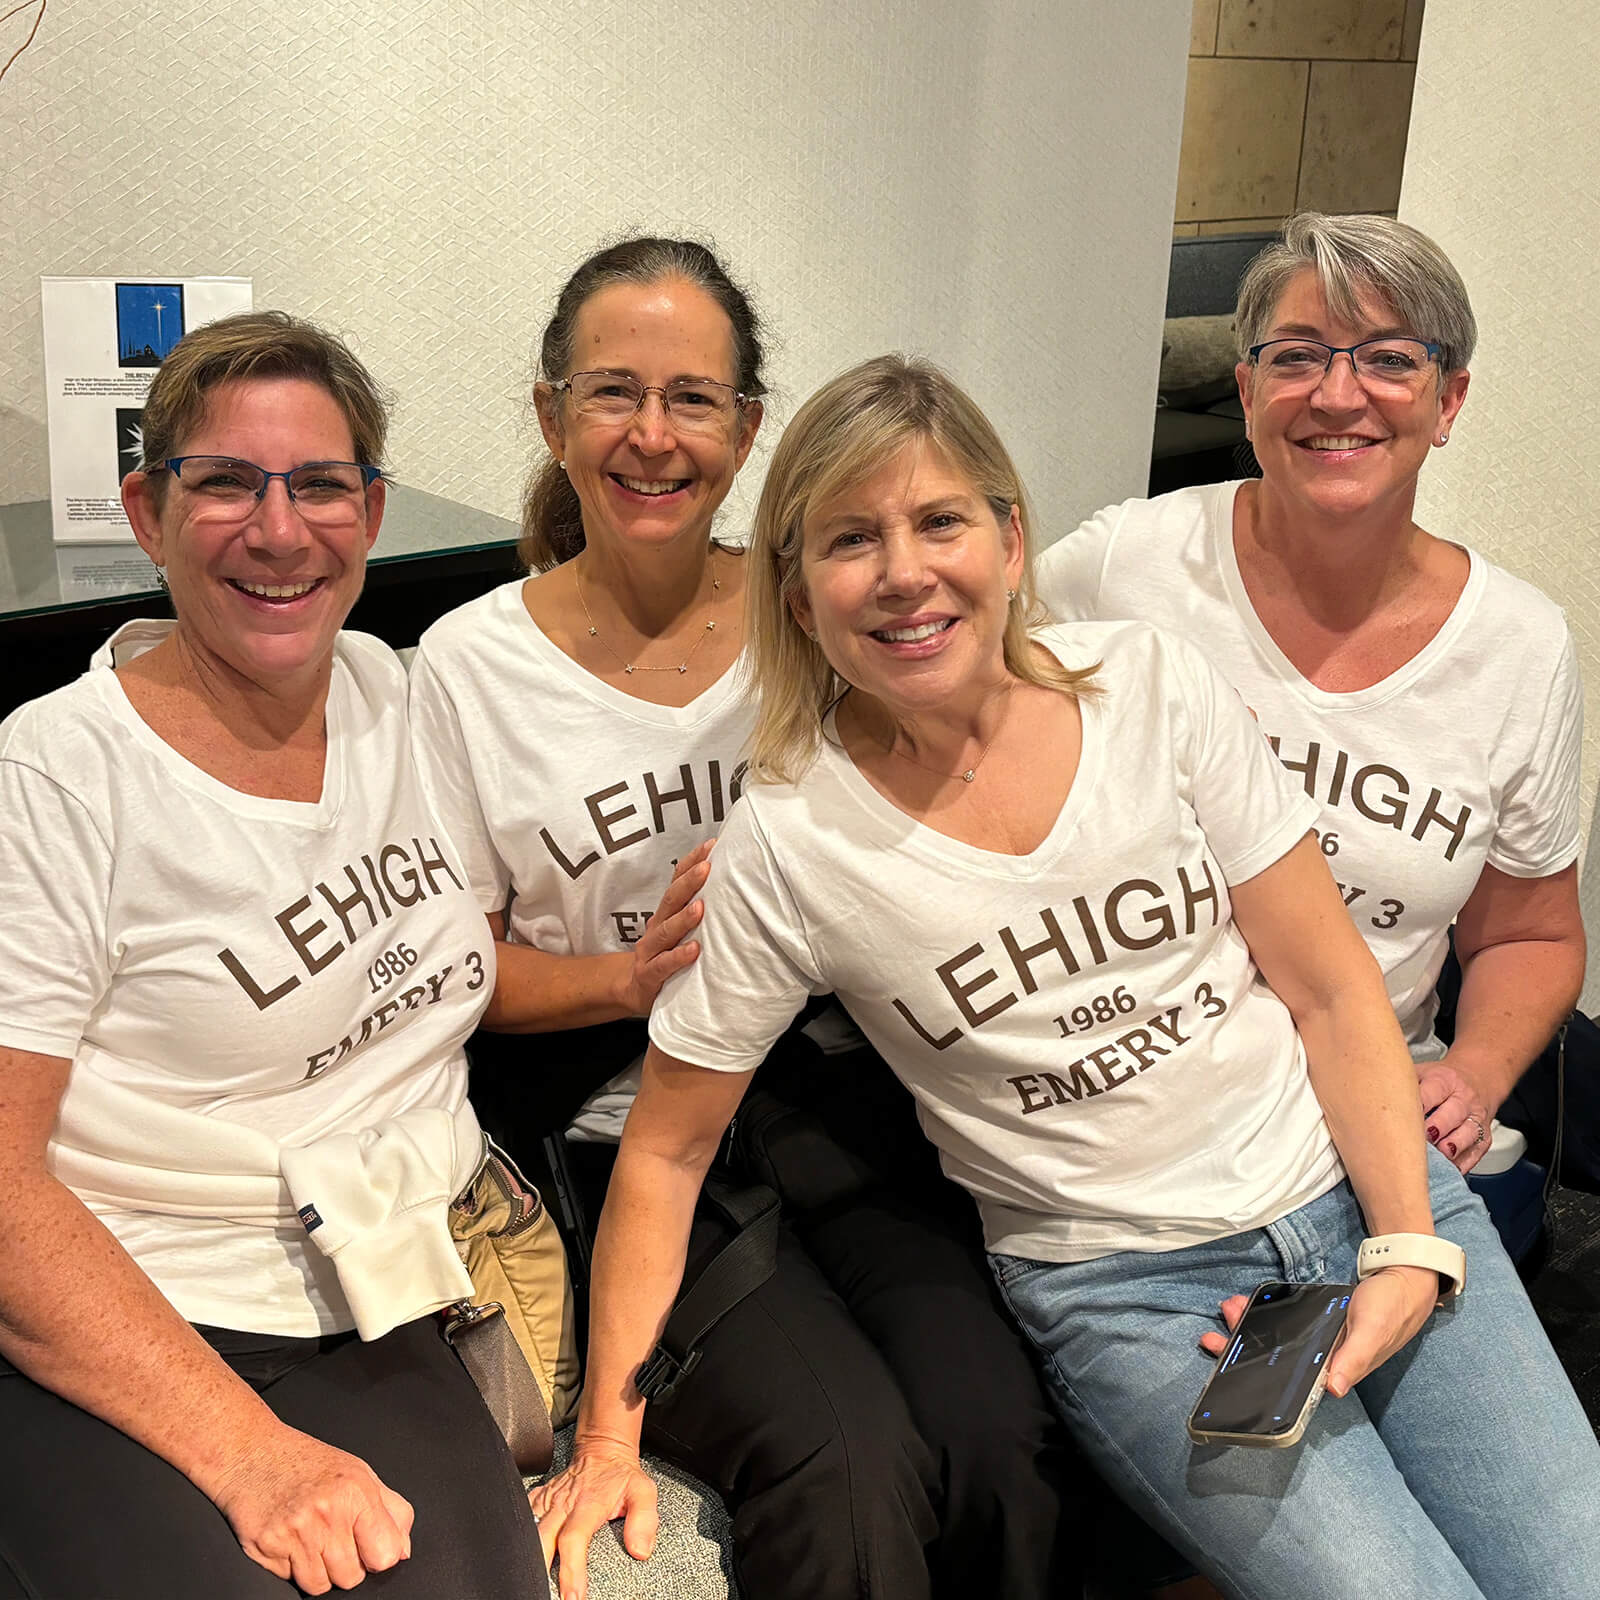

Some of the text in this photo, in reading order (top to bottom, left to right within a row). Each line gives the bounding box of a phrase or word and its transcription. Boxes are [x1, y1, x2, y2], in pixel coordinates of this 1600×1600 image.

[217, 838, 465, 1011] LEHIGH
[1371, 899, 1405, 929] 3
[365, 942, 418, 994] 1986
[465, 951, 485, 990] 3
[892, 860, 1219, 1050] LEHIGH
[1052, 985, 1137, 1039] 1986
[1006, 982, 1228, 1115] EMERY 3
